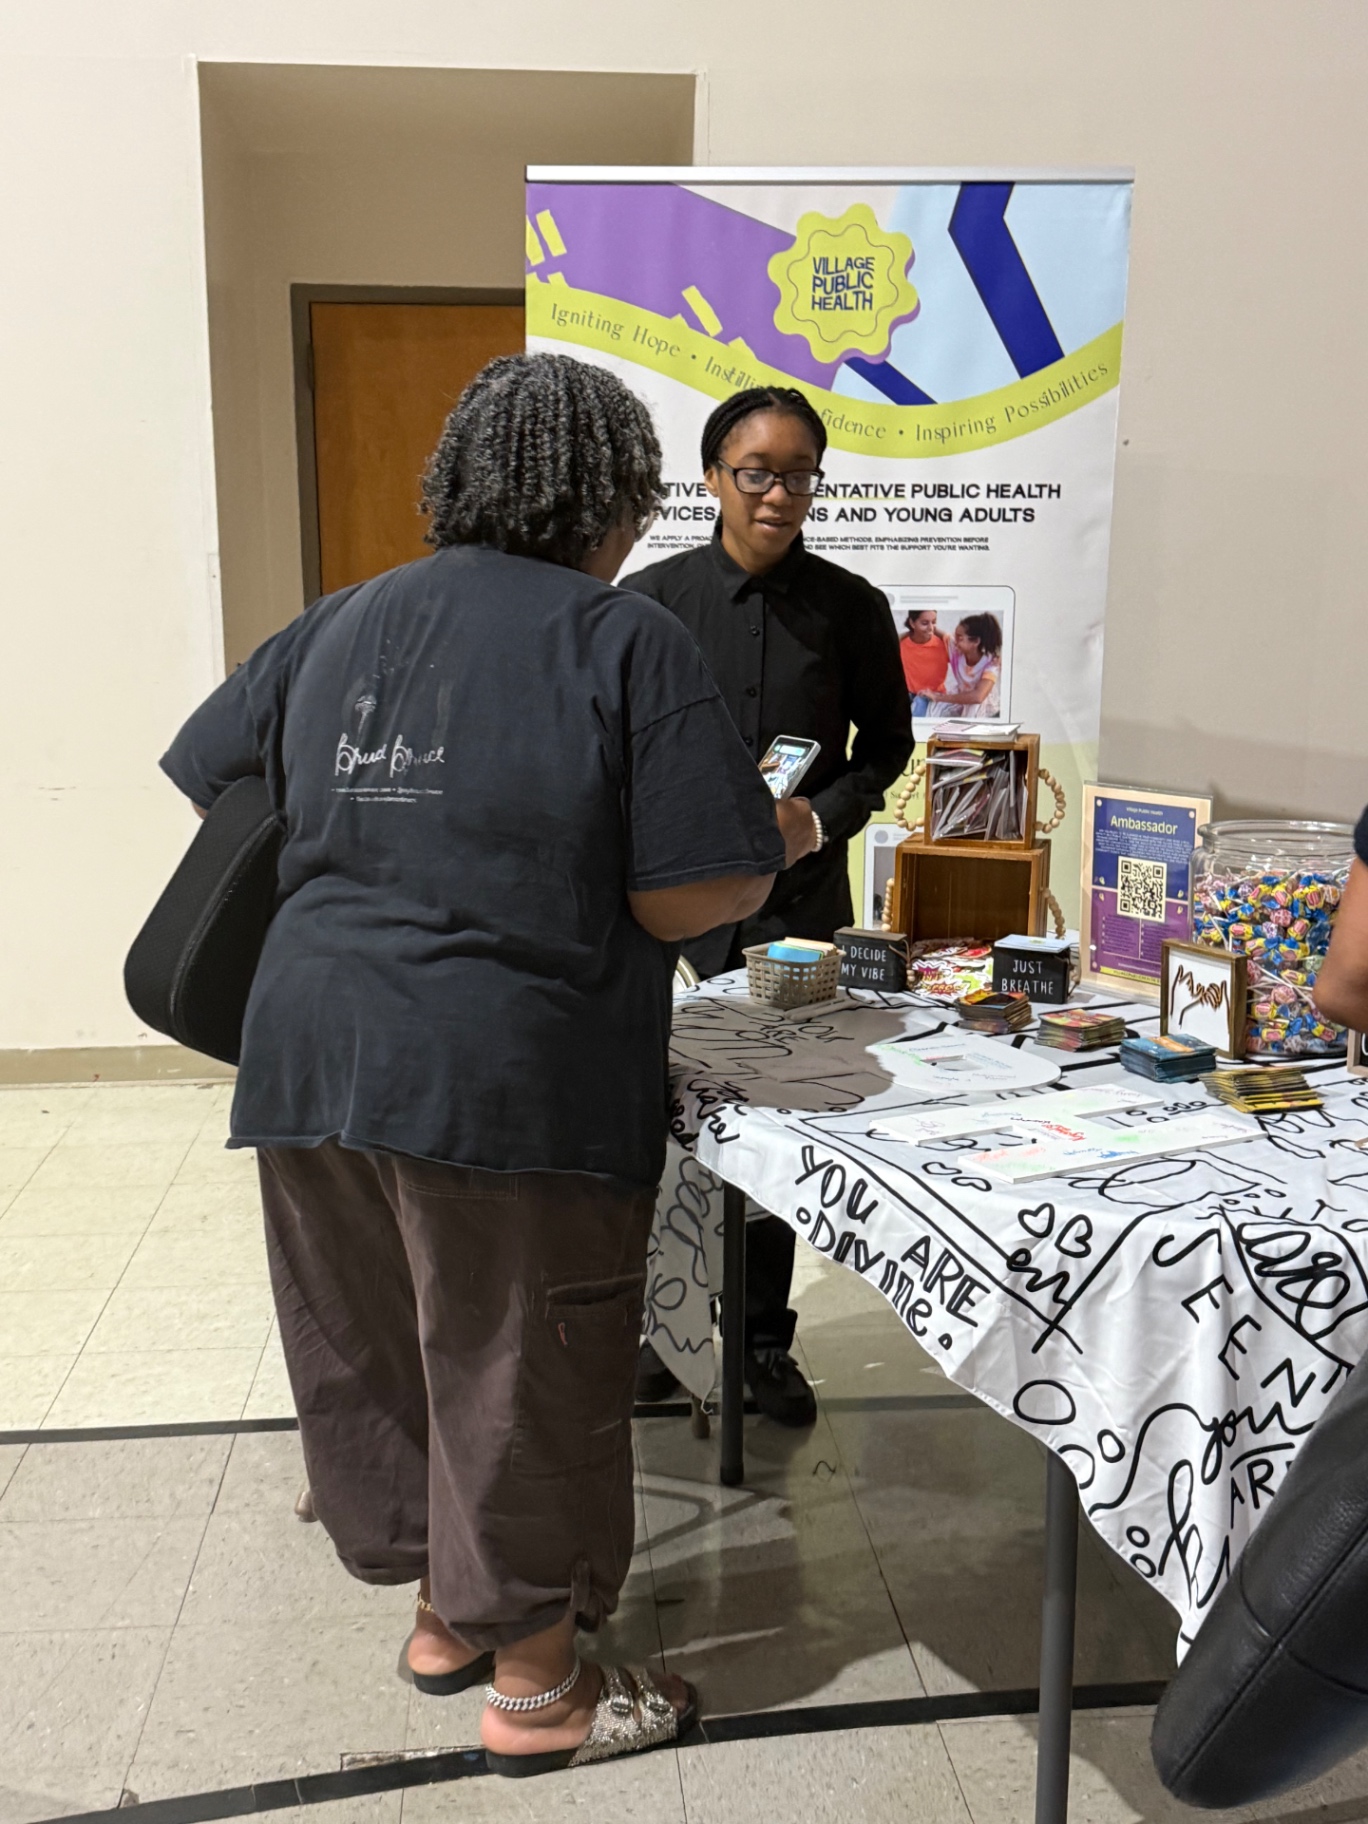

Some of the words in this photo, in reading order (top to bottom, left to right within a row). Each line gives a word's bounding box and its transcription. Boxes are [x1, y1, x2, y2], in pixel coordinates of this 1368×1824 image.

[812, 256, 876, 275] VILLAGE
[812, 270, 874, 295] PUBLIC
[811, 290, 873, 311] HEALTH
[551, 303, 625, 341] Igniting
[632, 324, 681, 357] Hope
[817, 408, 887, 439] fidence
[916, 414, 997, 445] Inspiring
[1004, 362, 1108, 424] Possibilities
[663, 482, 708, 498] TIVE
[814, 483, 906, 498] ENTATIVE
[911, 483, 981, 499] PUBLIC
[986, 483, 1061, 499] HEALTH
[660, 506, 716, 521] VICES
[835, 507, 877, 522] AND
[884, 507, 953, 523] YOUNG
[959, 507, 1036, 523] ADULTS
[1110, 815, 1178, 835] Ambassador
[850, 946, 887, 962] DECIDE
[841, 963, 857, 977] MY
[861, 967, 886, 981] VIBE
[1012, 959, 1043, 975] JUST
[1001, 978, 1055, 995] BREATHE
[795, 1145, 879, 1225] YOU
[900, 1235, 991, 1328] ARE
[1229, 1458, 1297, 1531] AR
